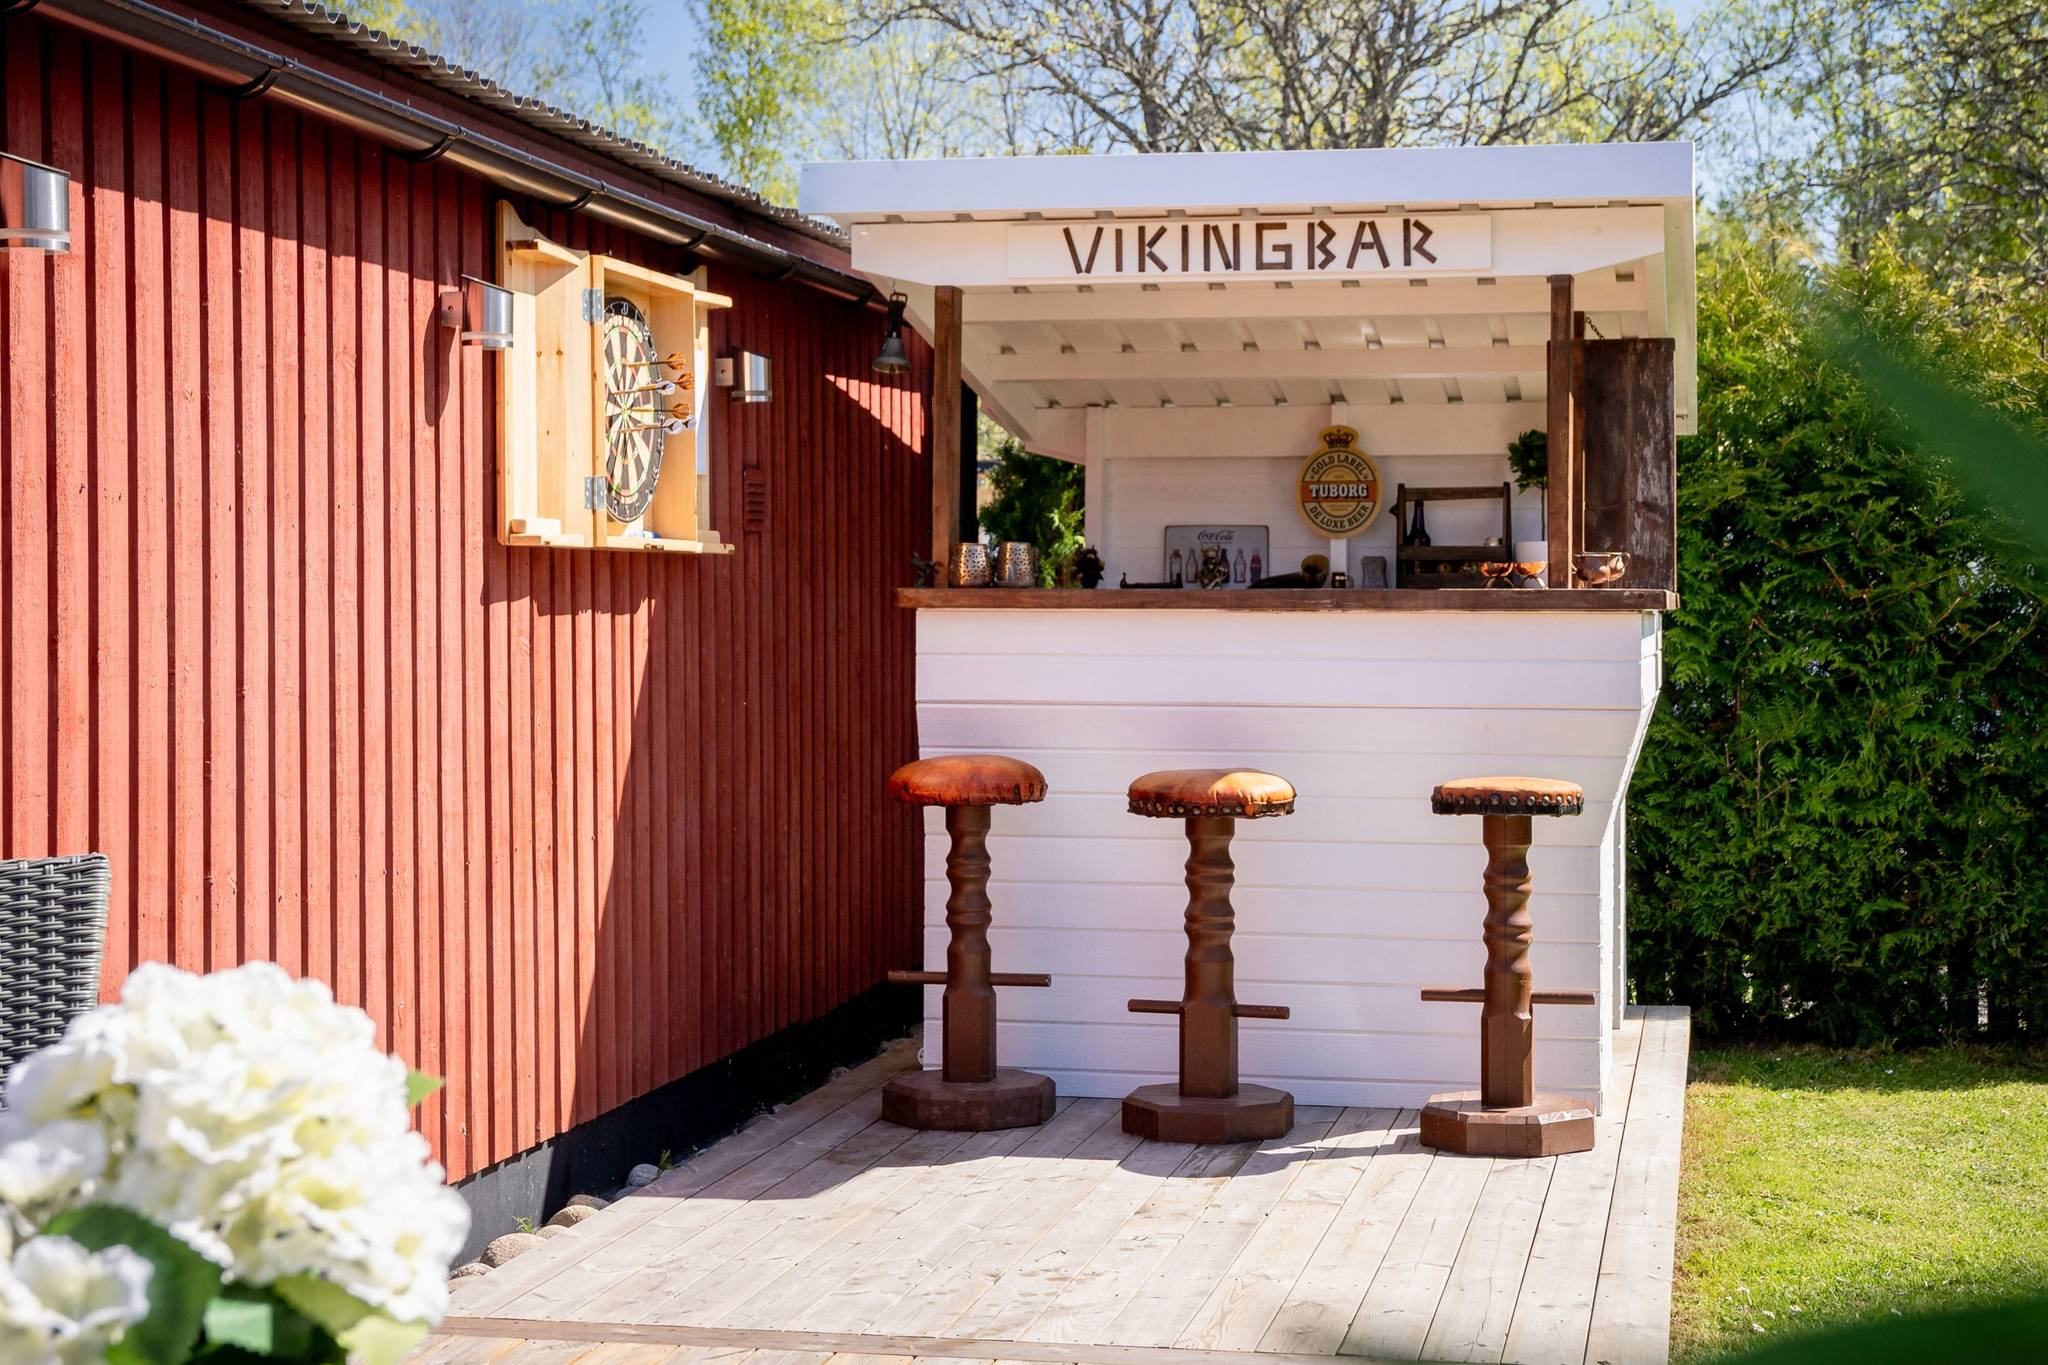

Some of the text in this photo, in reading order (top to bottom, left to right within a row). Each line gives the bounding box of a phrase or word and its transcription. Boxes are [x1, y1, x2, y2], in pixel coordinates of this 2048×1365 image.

[1063, 218, 1437, 274] VIKINGBAR
[1337, 454, 1367, 477] LABEL
[1309, 483, 1368, 498] TUBORG
[1310, 505, 1322, 520] DE
[1320, 516, 1346, 529] LUXE
[1346, 504, 1370, 527] BEER
